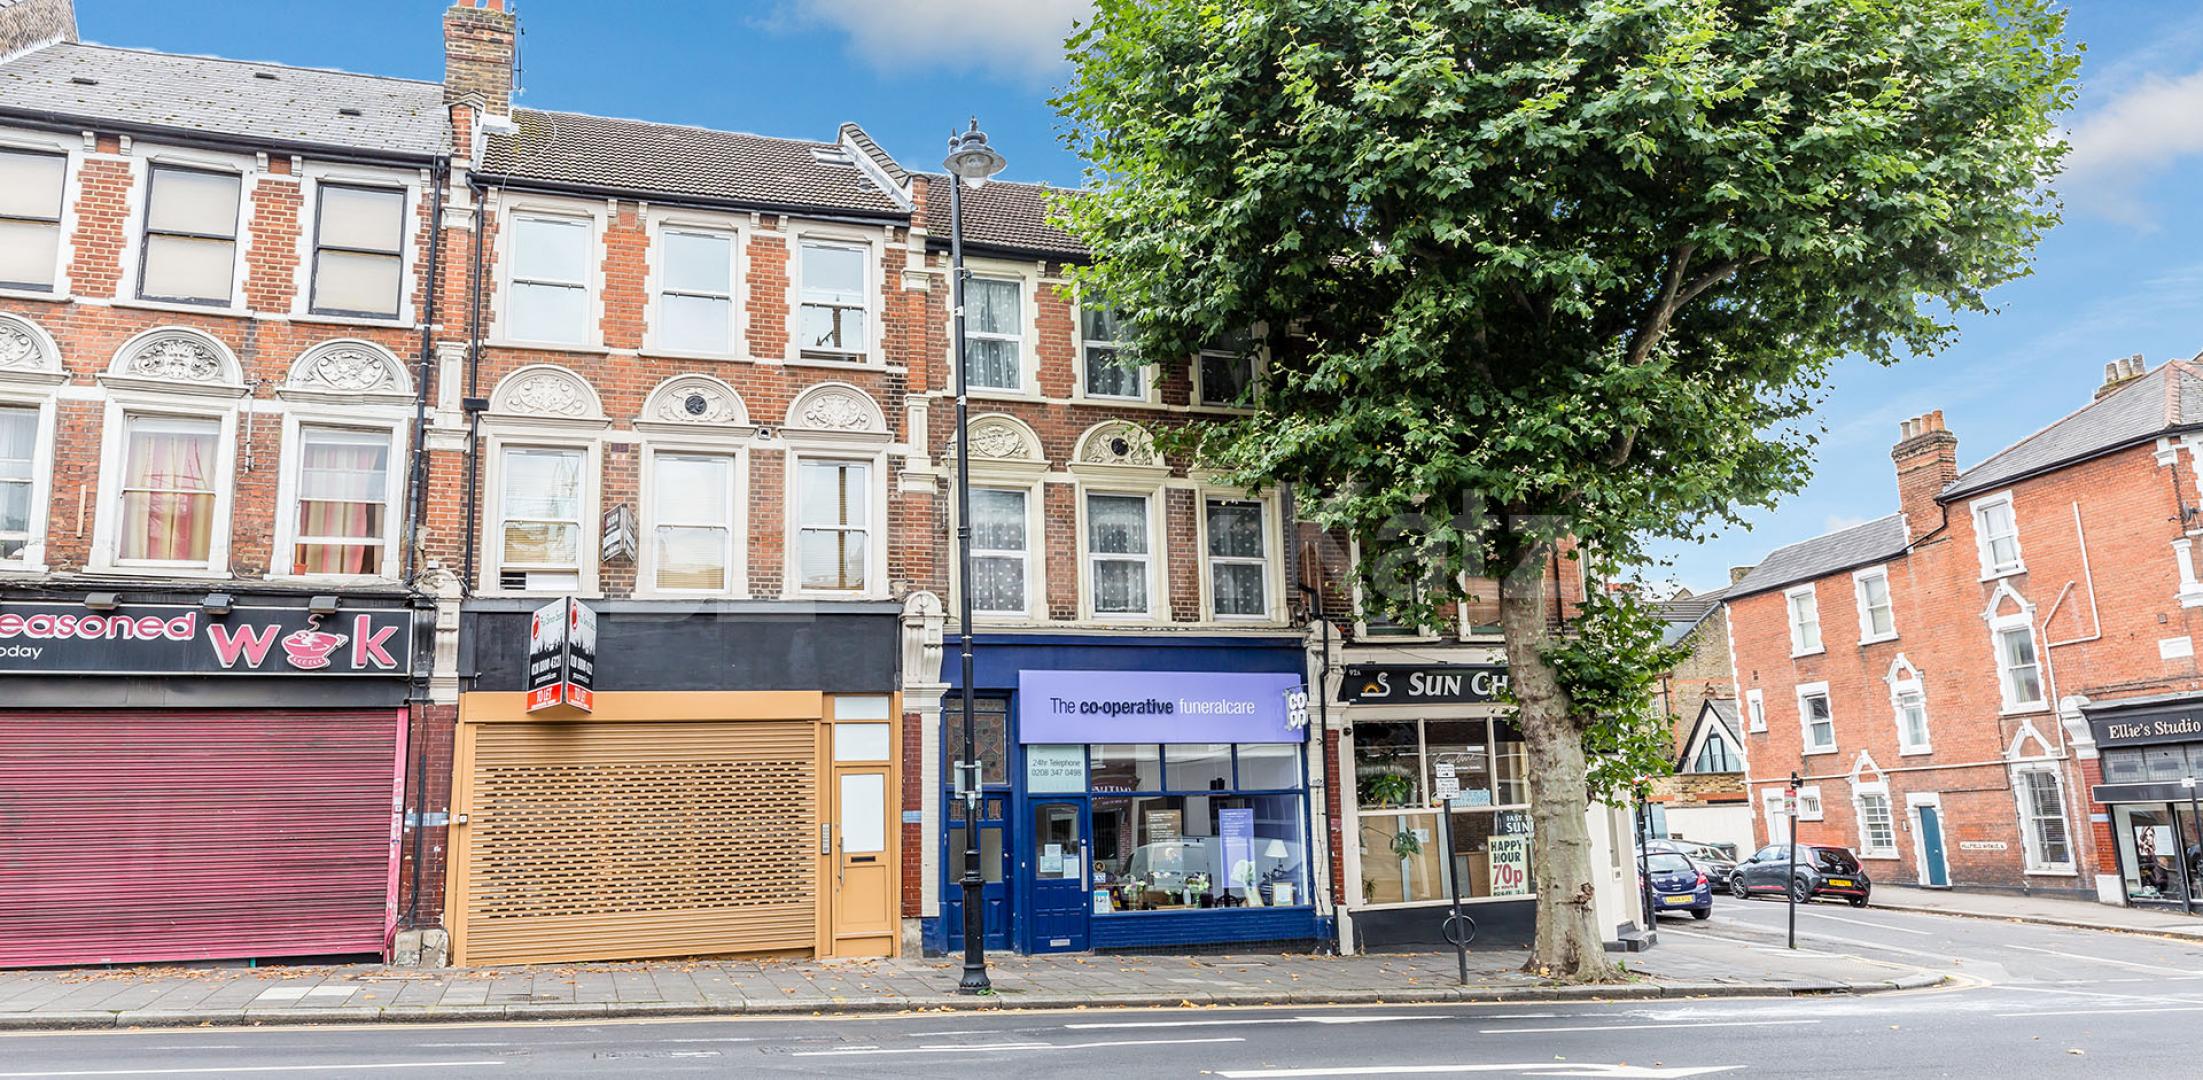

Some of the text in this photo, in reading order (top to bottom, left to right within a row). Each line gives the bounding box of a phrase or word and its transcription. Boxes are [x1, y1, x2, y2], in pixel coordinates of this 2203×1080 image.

[1408, 671, 1462, 697] SUN
[1050, 697, 1256, 717] The co-operative funeralcare
[2108, 717, 2202, 739] Ellie's Studio
[1491, 840, 1522, 852] HAPPY
[1493, 852, 1521, 864] HOUR
[1493, 863, 1523, 889] 70p
